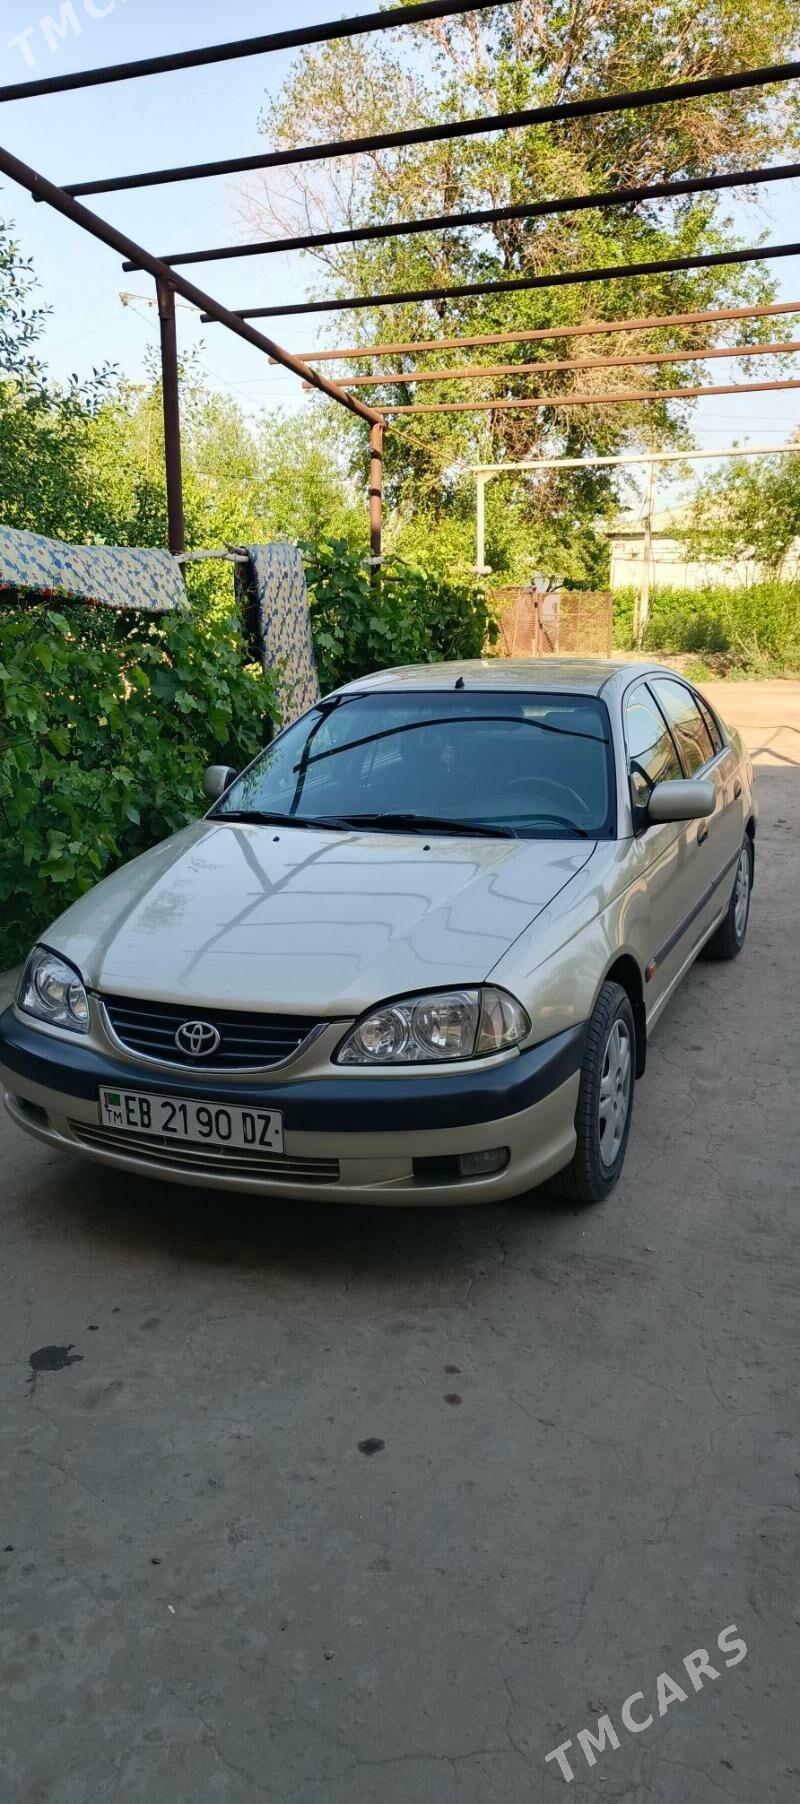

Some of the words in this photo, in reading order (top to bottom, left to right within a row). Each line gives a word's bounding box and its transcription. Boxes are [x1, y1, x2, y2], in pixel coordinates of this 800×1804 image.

[105, 1107, 123, 1125] TM
[124, 1095, 151, 1129] EB
[241, 1112, 273, 1147] DZ
